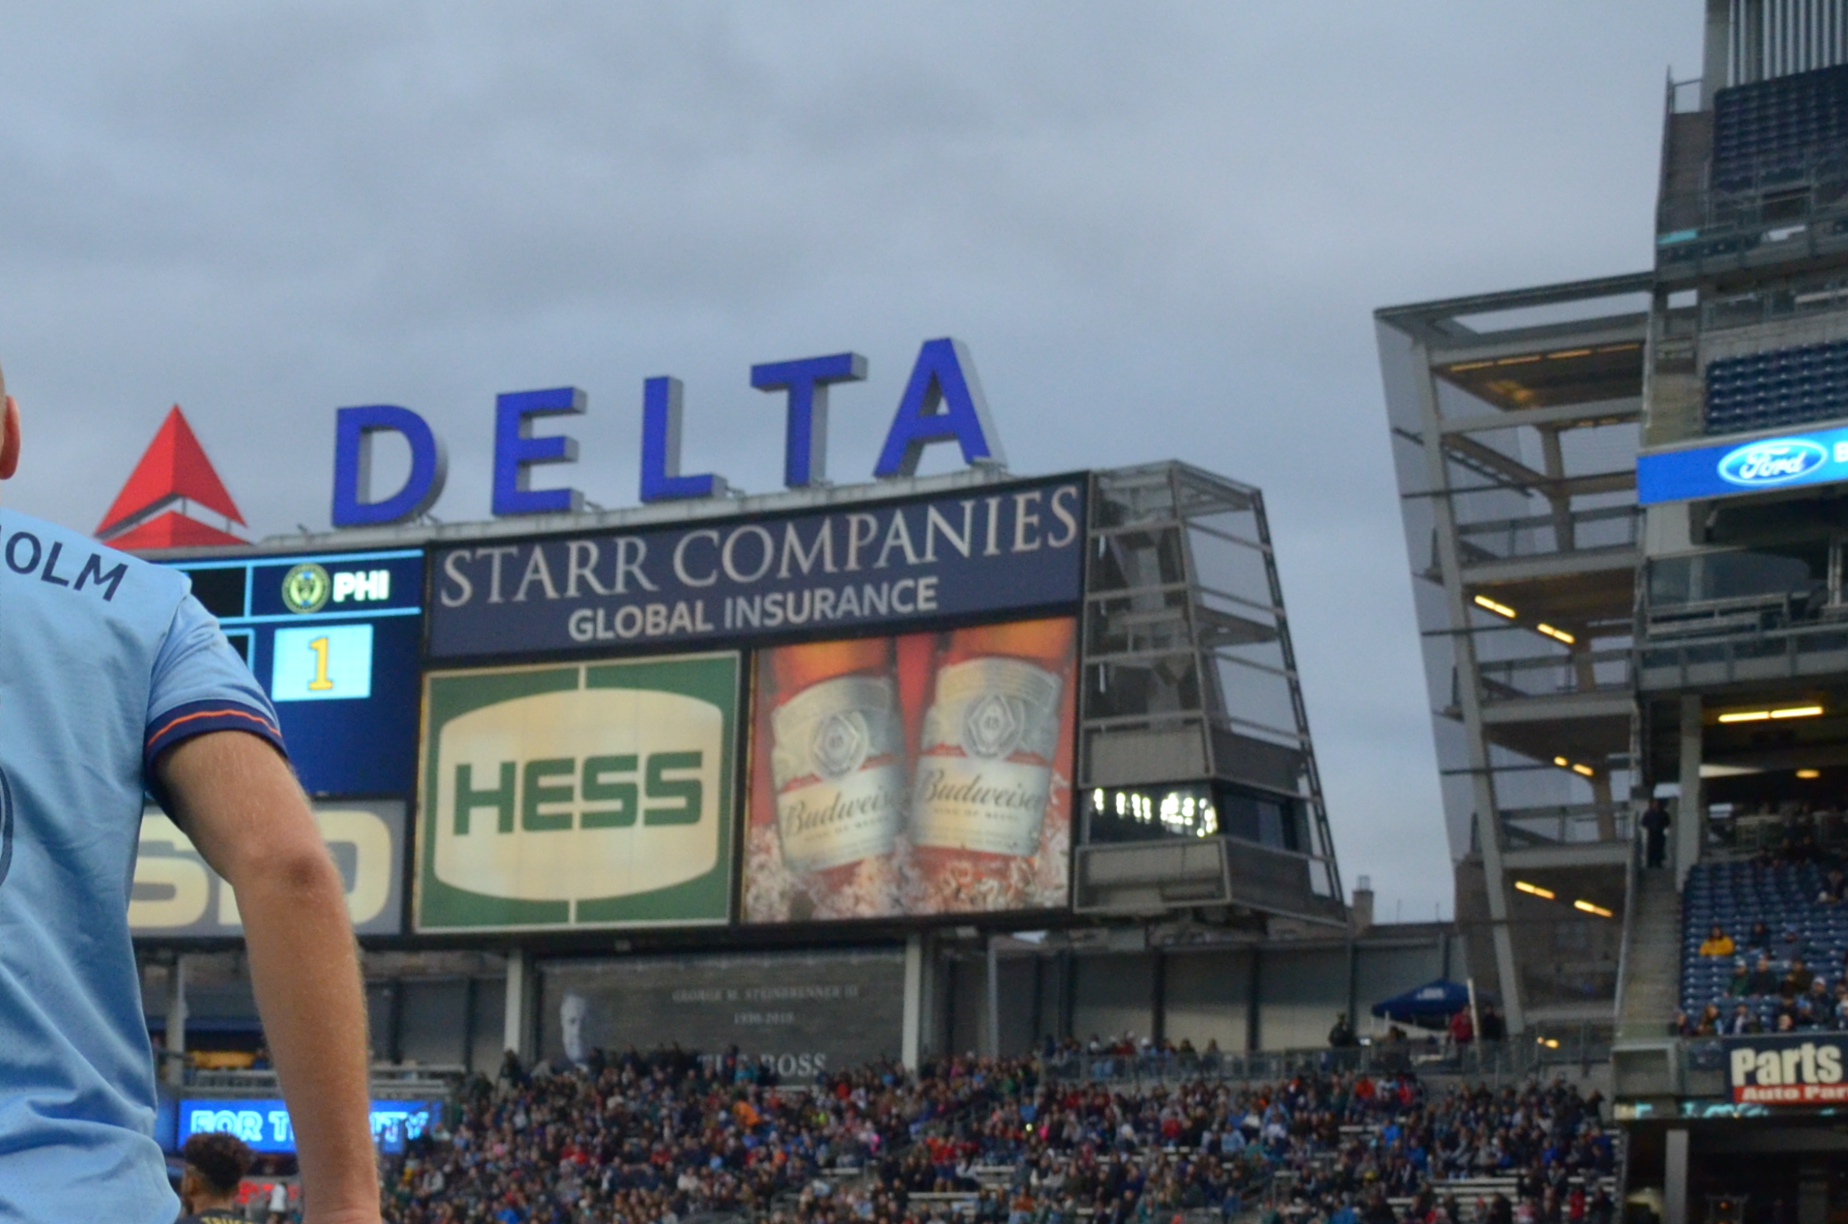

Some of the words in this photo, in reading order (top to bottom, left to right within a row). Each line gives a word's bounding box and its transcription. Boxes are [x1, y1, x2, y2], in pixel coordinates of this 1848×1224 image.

[331, 336, 1007, 528] DELTA
[1738, 447, 1806, 480] Ford
[440, 535, 662, 608] STARR
[673, 485, 1078, 589] COMPANIES
[333, 570, 390, 602] PHI
[568, 598, 714, 642] GLOBAL
[724, 577, 939, 629] INSURANCE
[308, 637, 334, 690] 1
[452, 750, 704, 836] HESS
[786, 785, 899, 838] Budweis
[1730, 1042, 1844, 1087] Parts
[1742, 1086, 1800, 1101] Auto
[190, 1110, 263, 1143] FOR
